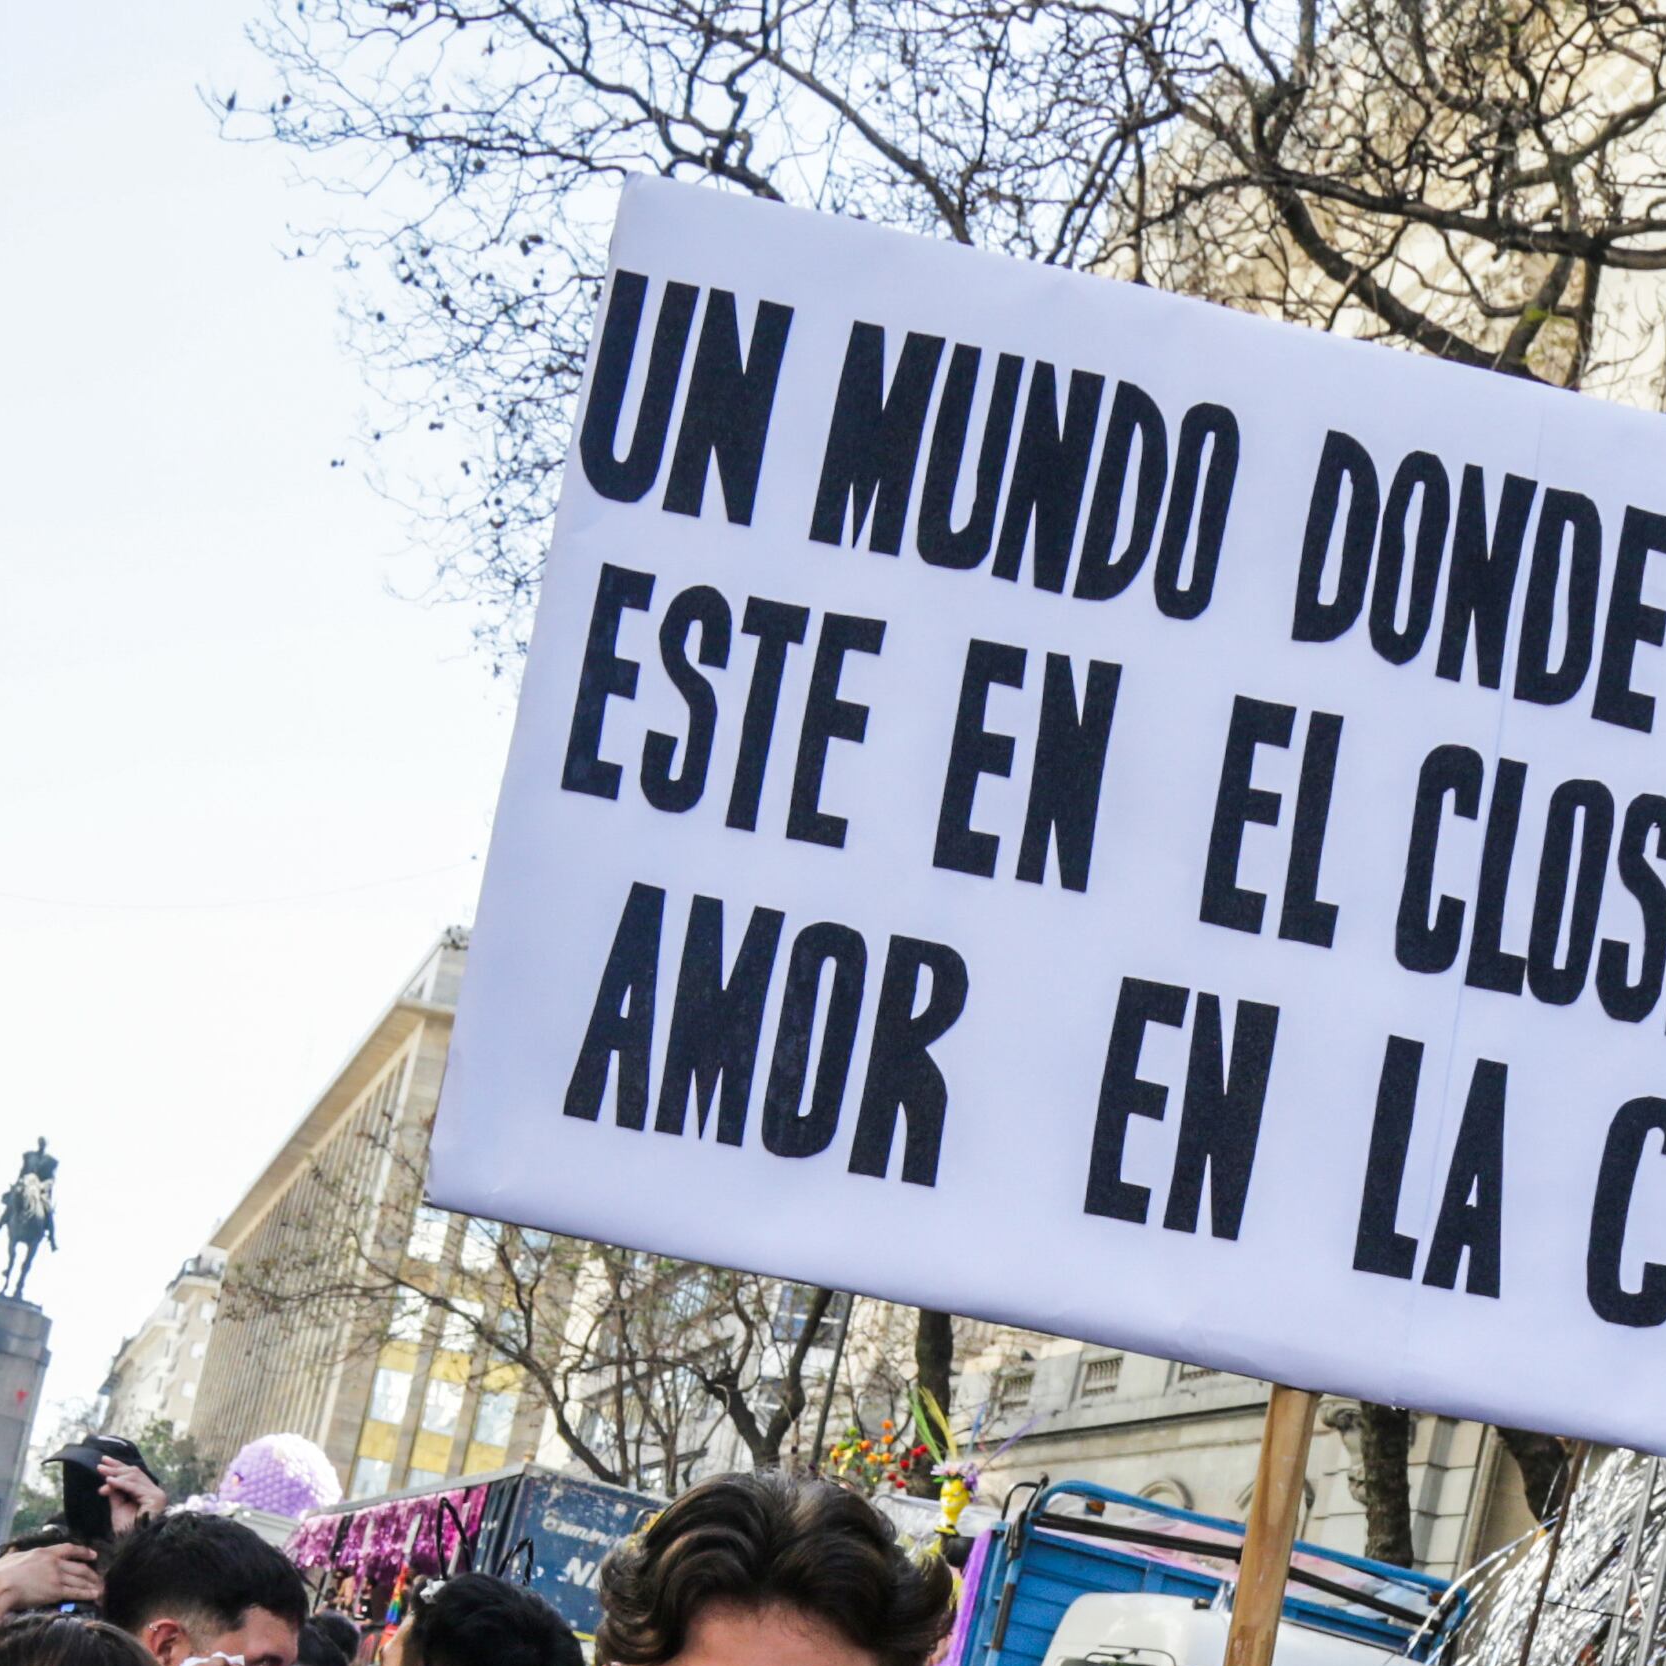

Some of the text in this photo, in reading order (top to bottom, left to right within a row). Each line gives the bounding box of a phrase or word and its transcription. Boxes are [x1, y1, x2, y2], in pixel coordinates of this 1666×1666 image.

[580, 269, 794, 526] UN
[809, 321, 1239, 620] MUNDO
[561, 563, 886, 848] ESTE
[933, 639, 1122, 893] EN
[1200, 695, 1343, 948] EL
[563, 882, 968, 1187] AMOR
[1084, 977, 1279, 1241] EN
[1353, 1035, 1508, 1298] LA
